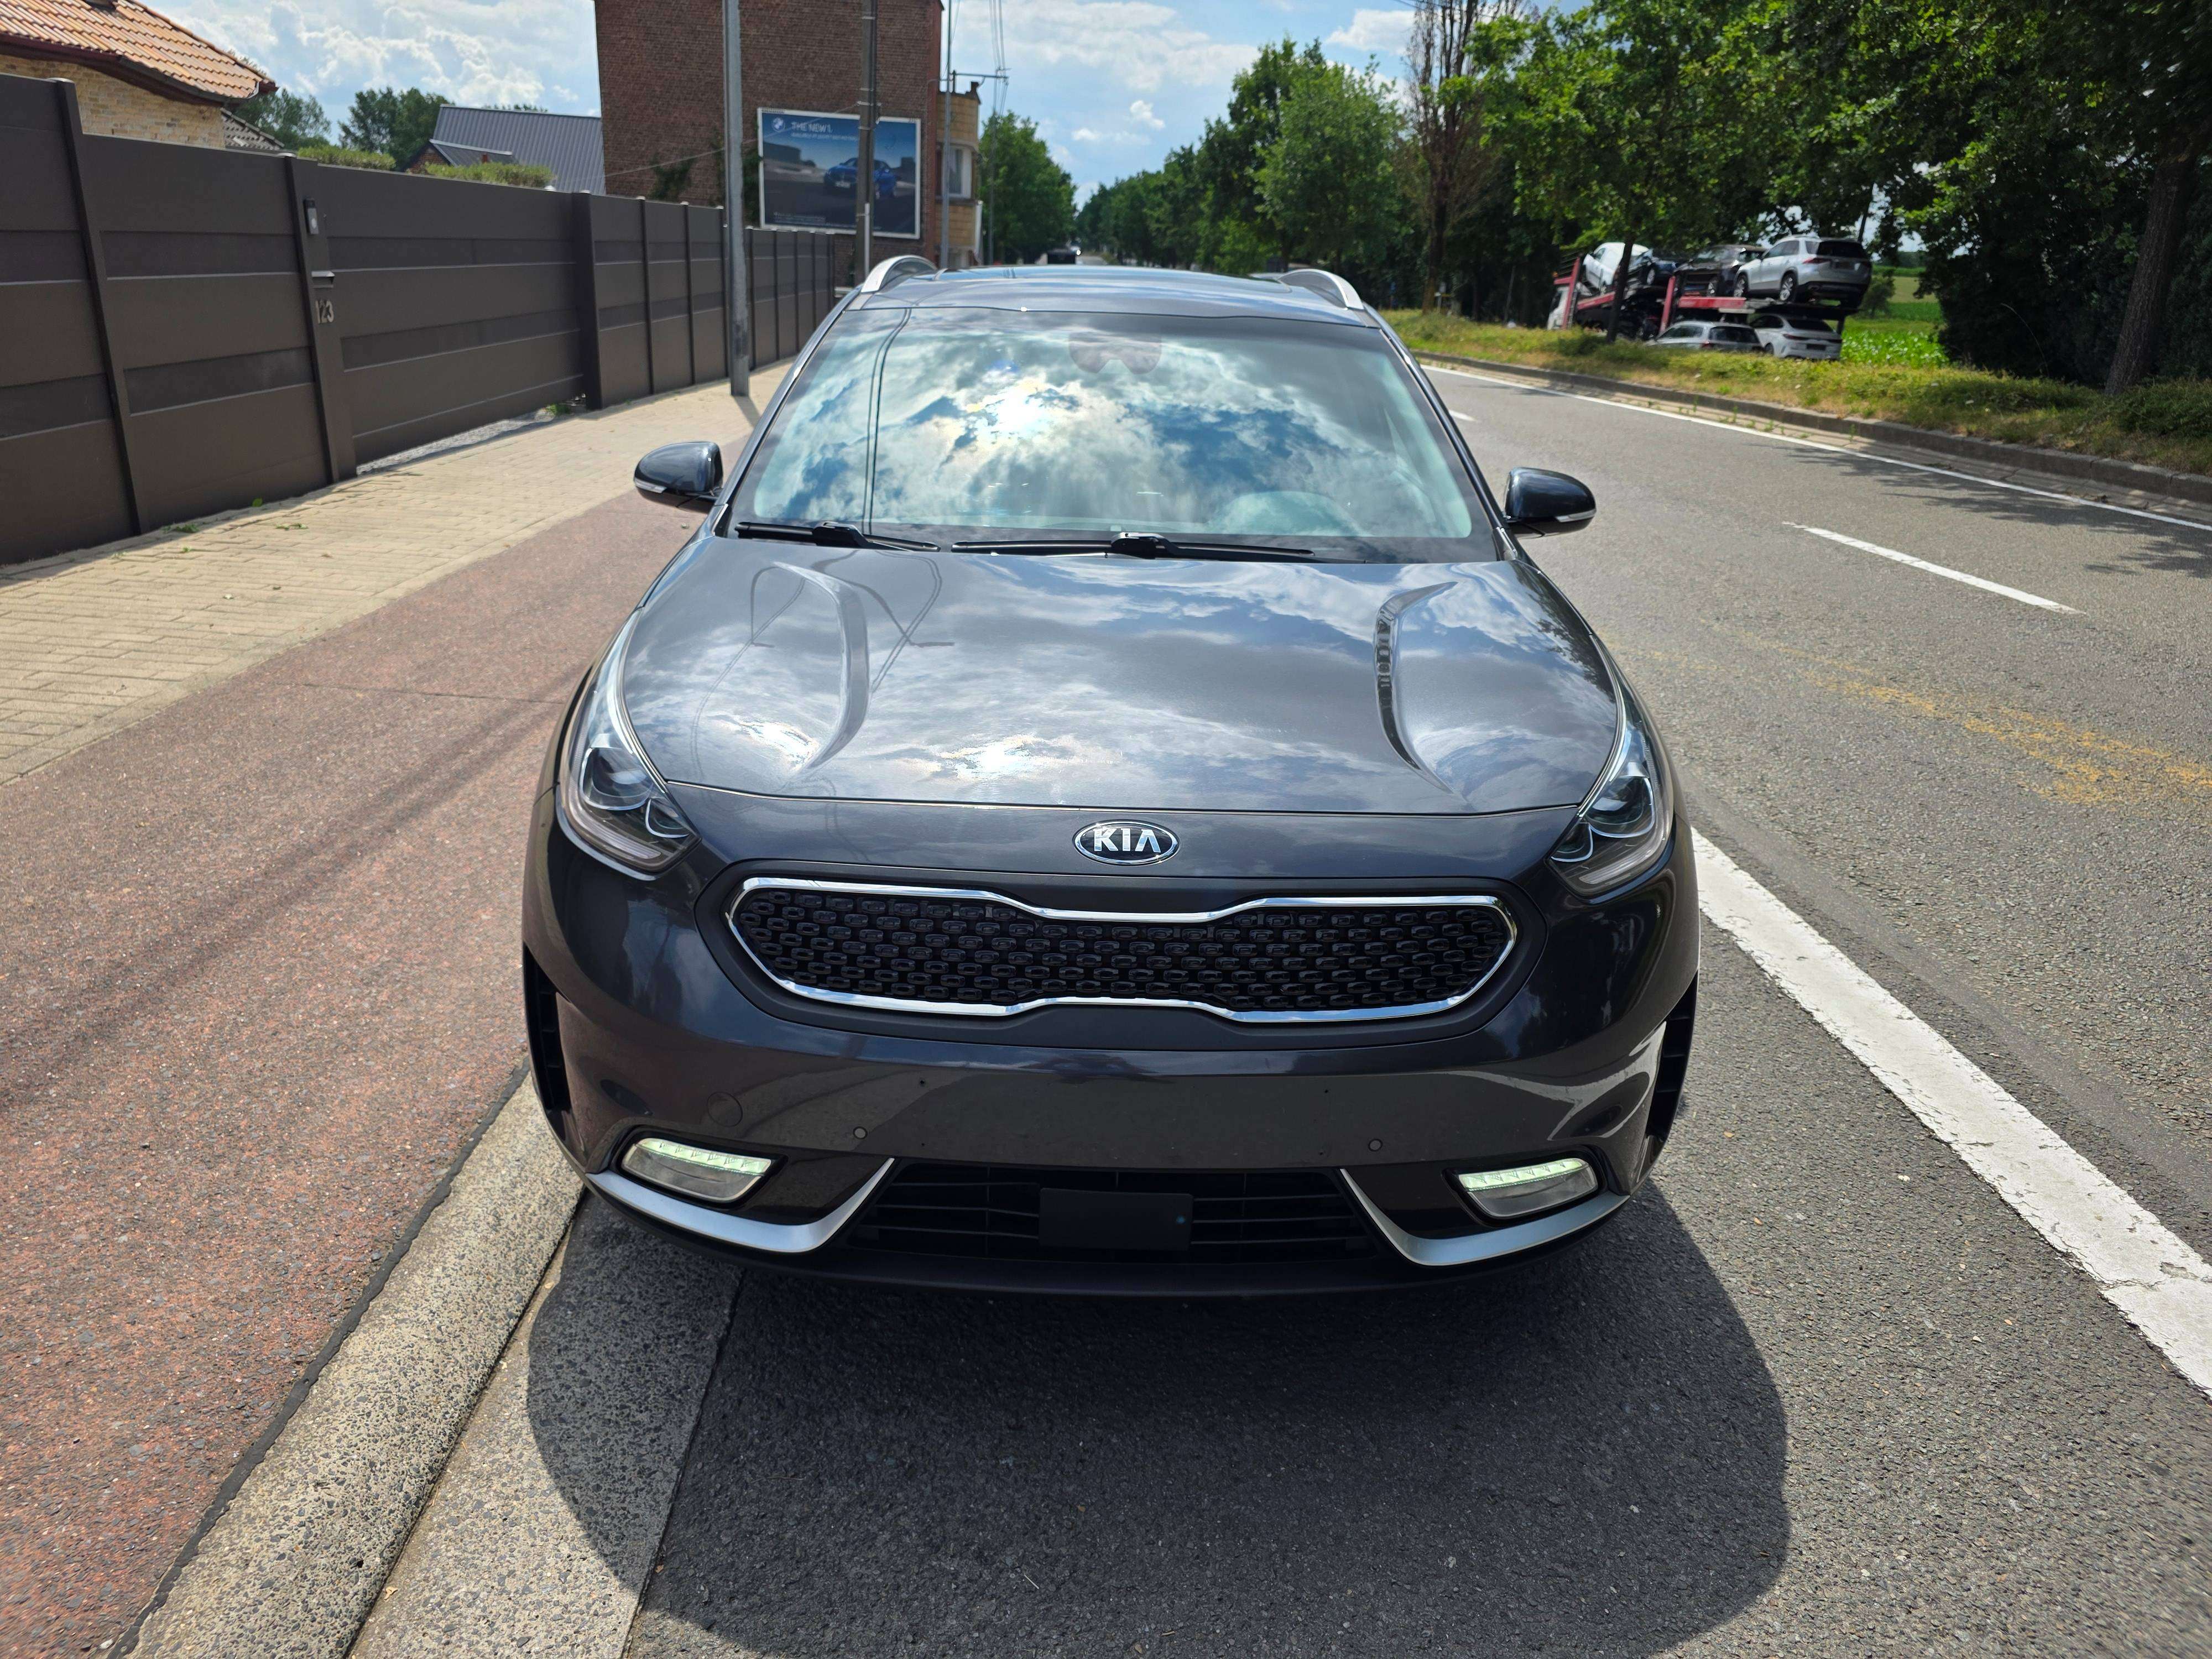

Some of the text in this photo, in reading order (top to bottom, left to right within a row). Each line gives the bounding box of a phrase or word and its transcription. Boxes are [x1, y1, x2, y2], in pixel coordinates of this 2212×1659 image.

[791, 122, 806, 132] THE
[808, 123, 826, 133] NEW
[315, 300, 333, 324] 123
[1093, 827, 1161, 853] KIA
